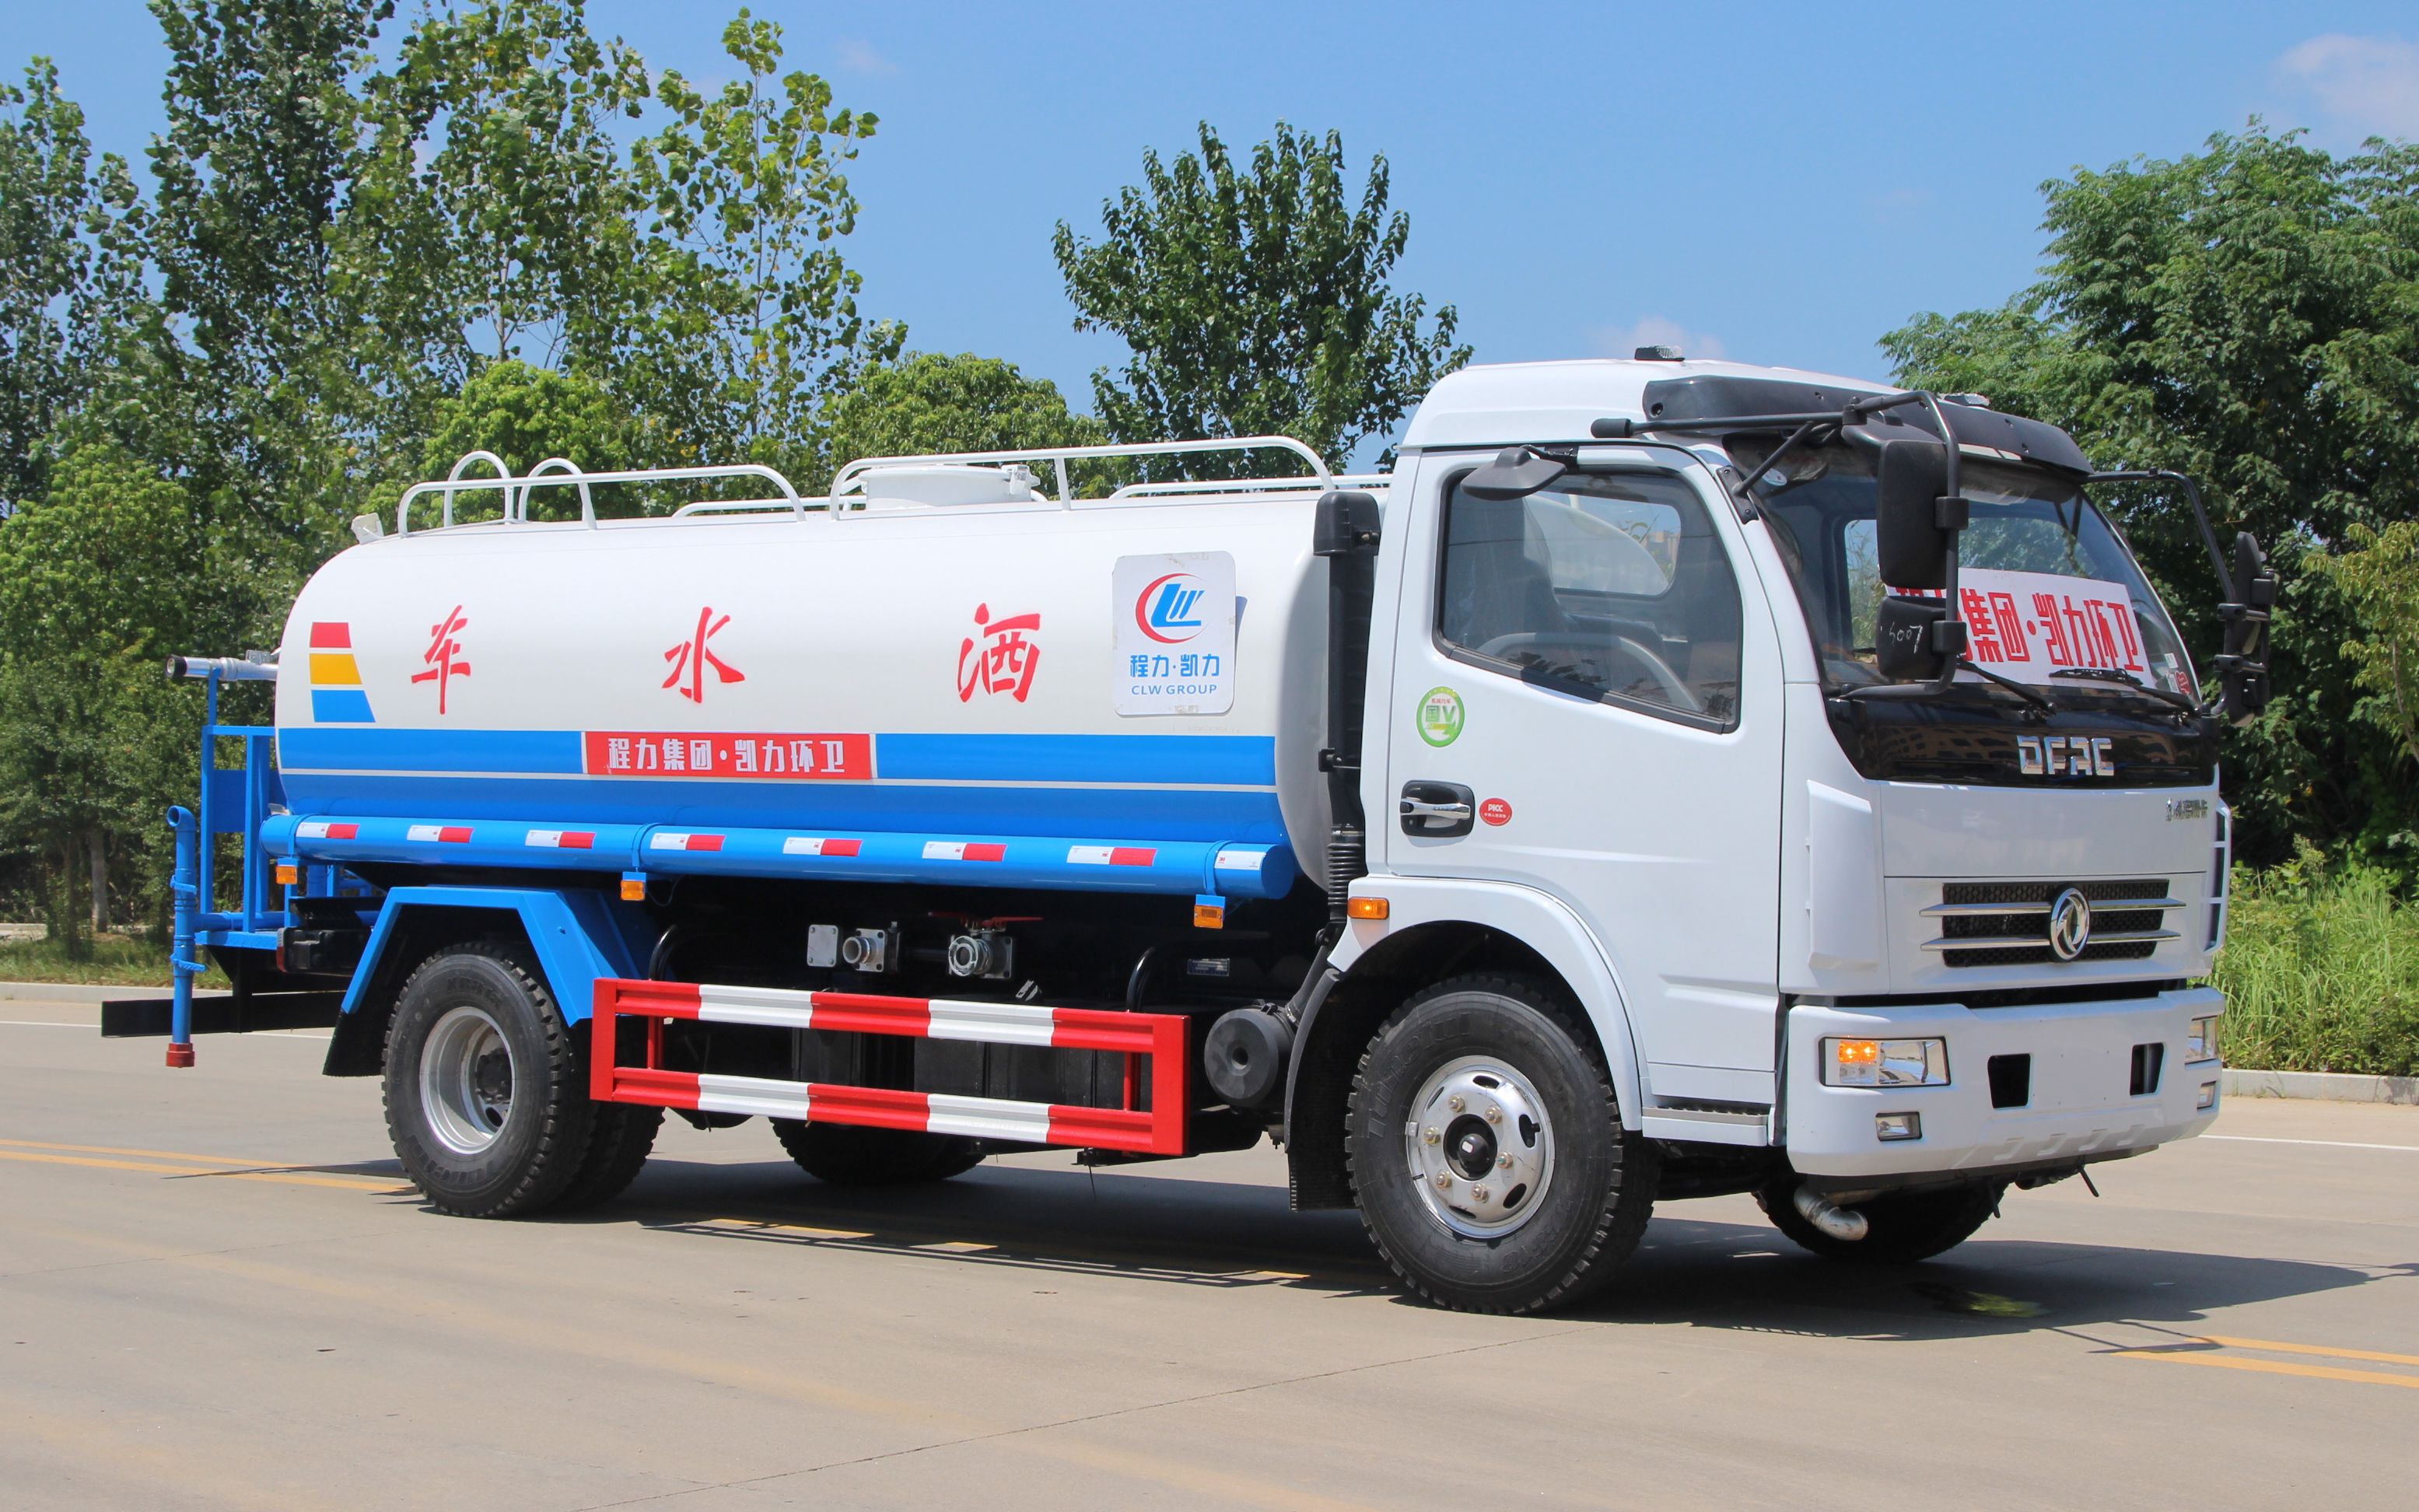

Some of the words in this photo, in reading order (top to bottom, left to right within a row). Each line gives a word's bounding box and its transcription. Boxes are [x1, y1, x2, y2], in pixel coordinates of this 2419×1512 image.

[1896, 587, 2144, 672] 集团·凯力环卫
[662, 606, 747, 705] 水
[1129, 653, 1220, 678] 程力·凯力
[1131, 684, 1163, 696] CLW
[1165, 683, 1218, 696] GROUP
[608, 737, 845, 773] 程力集团·凯力环卫
[2016, 734, 2115, 776] DFAC
[1487, 803, 1504, 813] PICC
